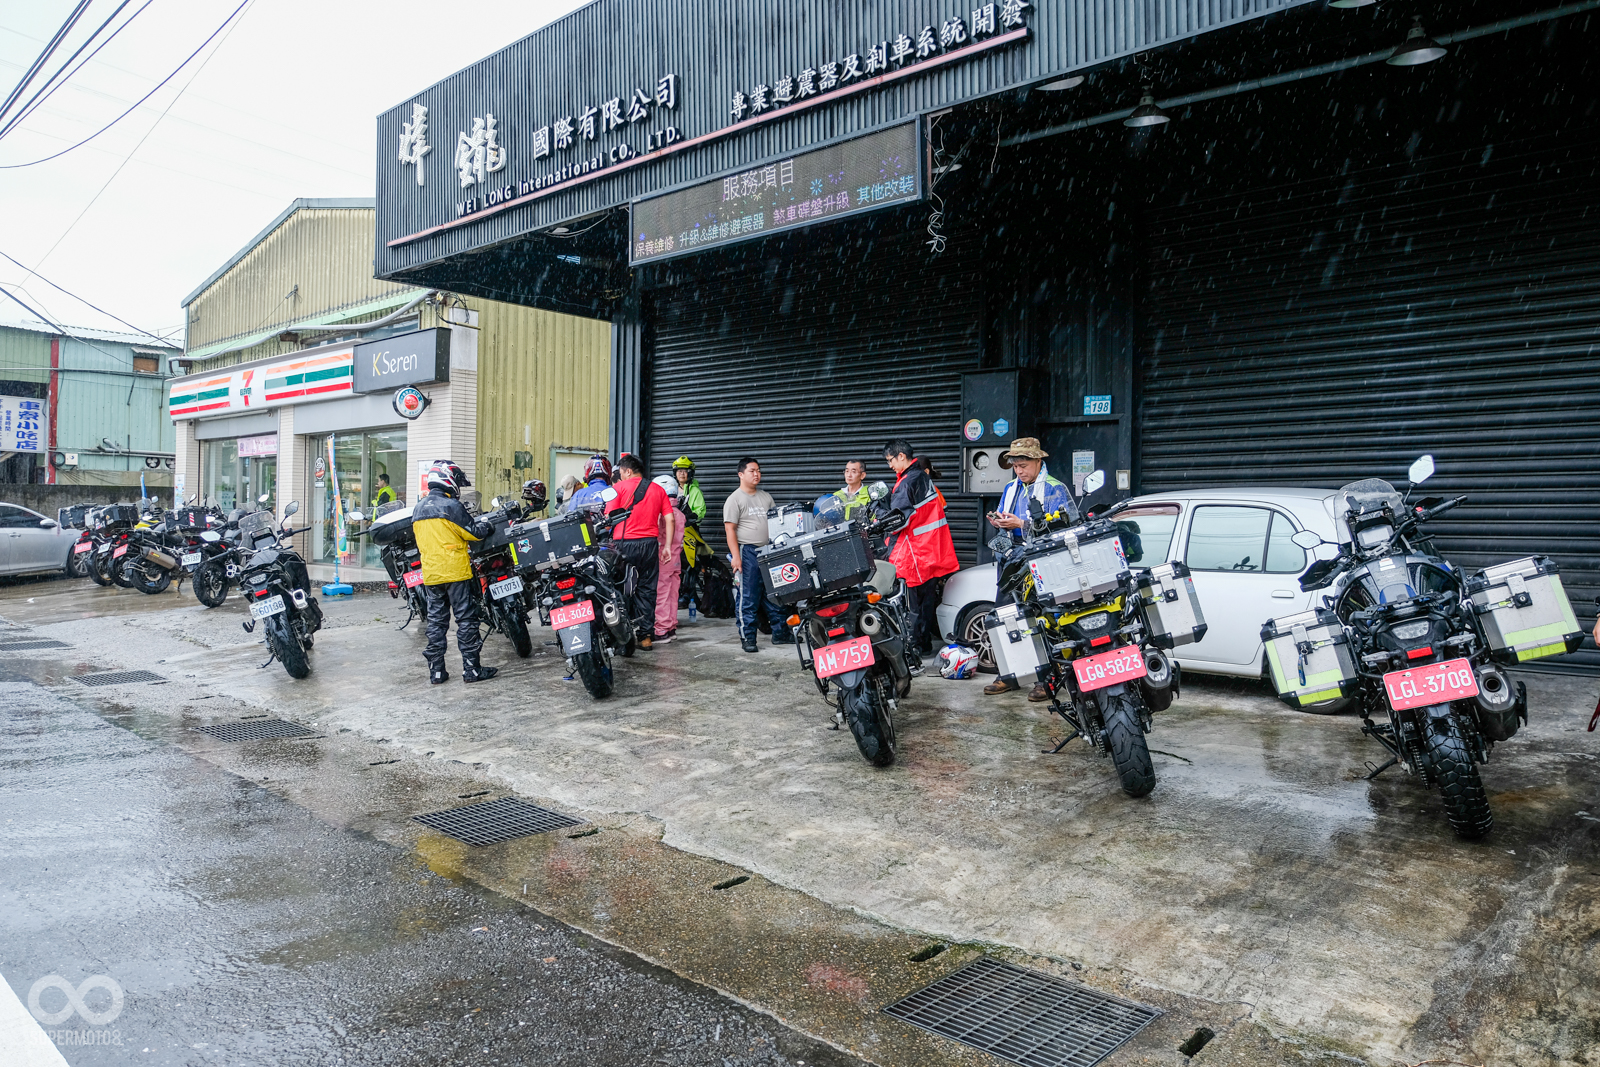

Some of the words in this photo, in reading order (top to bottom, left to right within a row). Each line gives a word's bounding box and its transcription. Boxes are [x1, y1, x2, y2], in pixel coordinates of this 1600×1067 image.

[532, 73, 677, 160] 國際有限公司
[457, 197, 477, 217] WEI
[484, 185, 512, 208] LONG
[519, 152, 603, 196] International
[648, 126, 681, 150] LTD.
[722, 159, 794, 202] 服務項目
[857, 175, 915, 205] 其他改裝
[1092, 401, 1110, 413] 198
